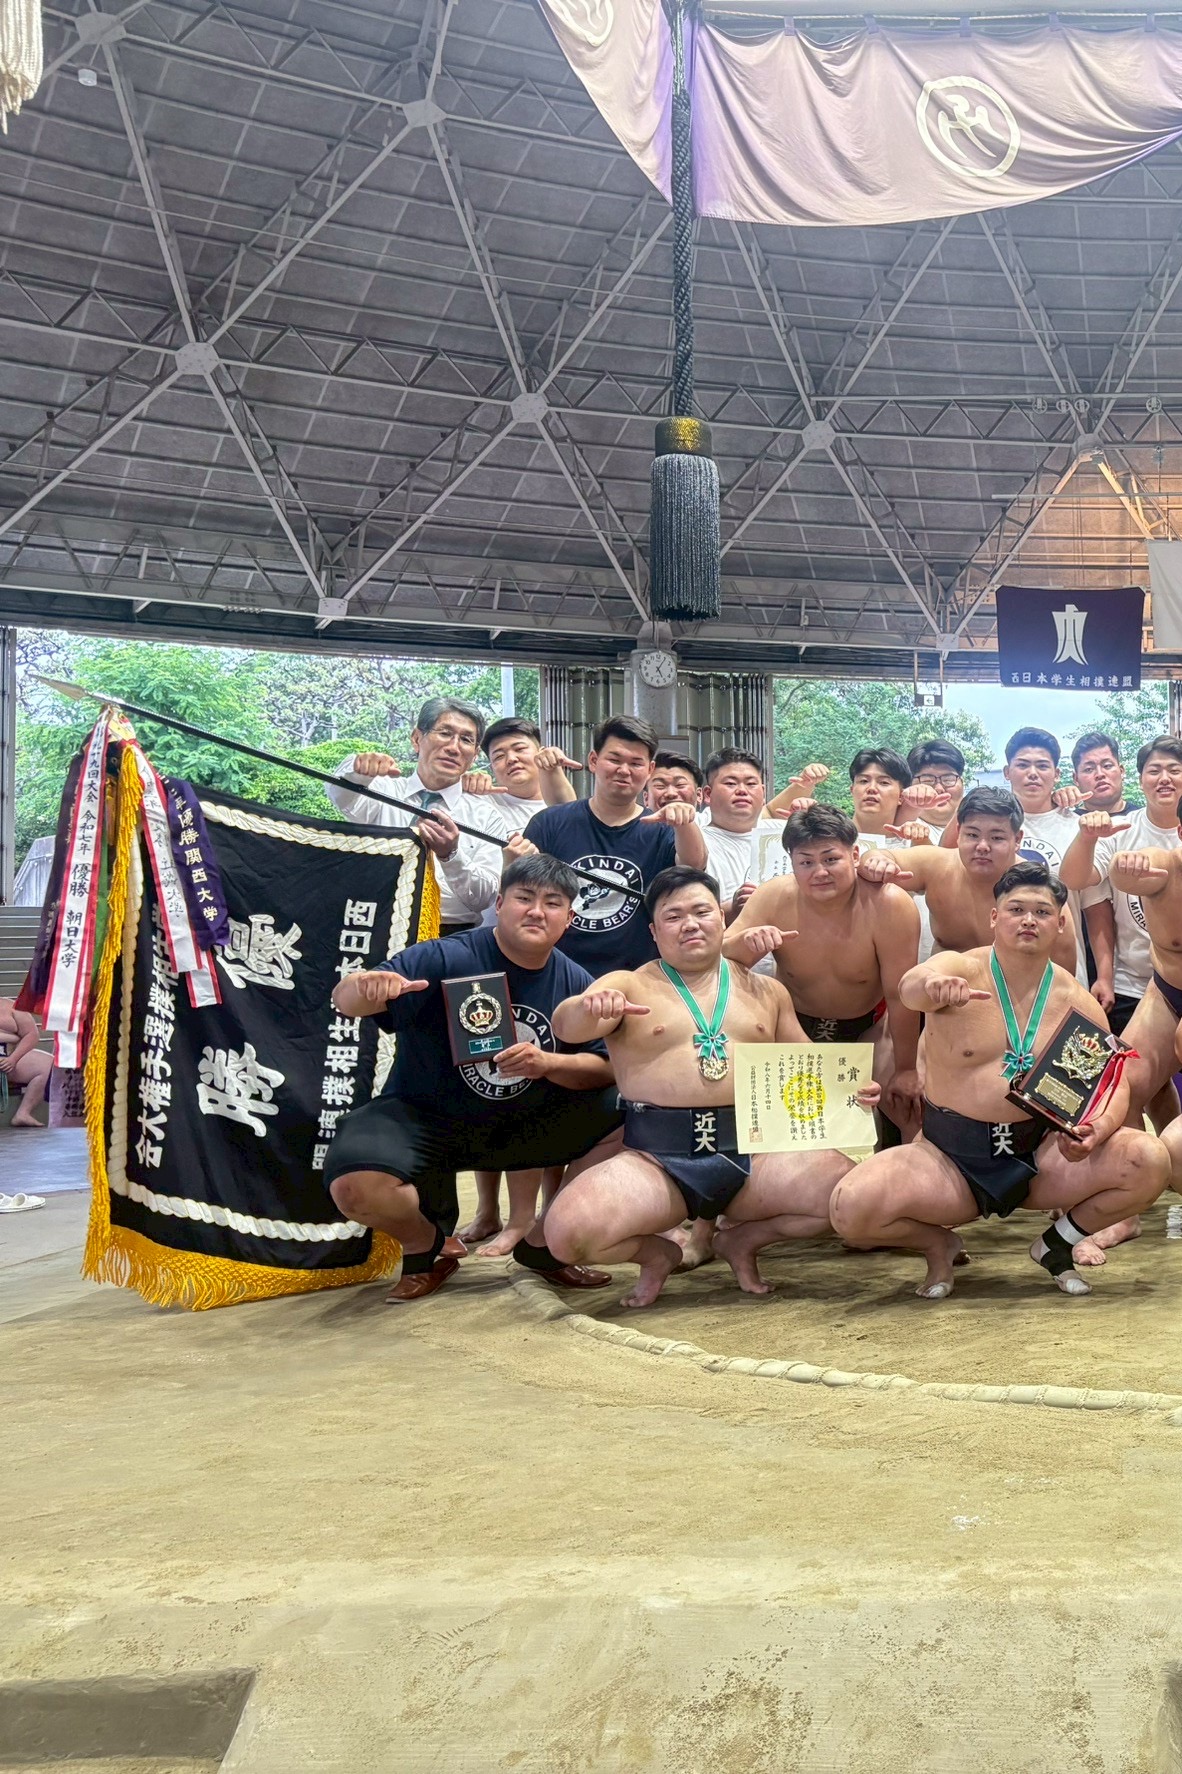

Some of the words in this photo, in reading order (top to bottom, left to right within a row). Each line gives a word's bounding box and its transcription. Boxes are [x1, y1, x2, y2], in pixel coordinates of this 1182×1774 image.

[1011, 671, 1133, 687] 西日本学生相撲連盟
[78, 810, 97, 855] 令和七年
[1023, 840, 1060, 867] NDAI
[68, 862, 92, 898] 優勝
[61, 910, 83, 968] 朝日大学
[196, 914, 302, 1137] 優勝
[512, 1008, 551, 1044] NDAI
[815, 1018, 838, 1041] 近大
[462, 1063, 505, 1096] IRACLE
[846, 1066, 861, 1109] 賞状
[693, 1111, 717, 1152] 近大
[991, 1122, 1015, 1156] 近大
